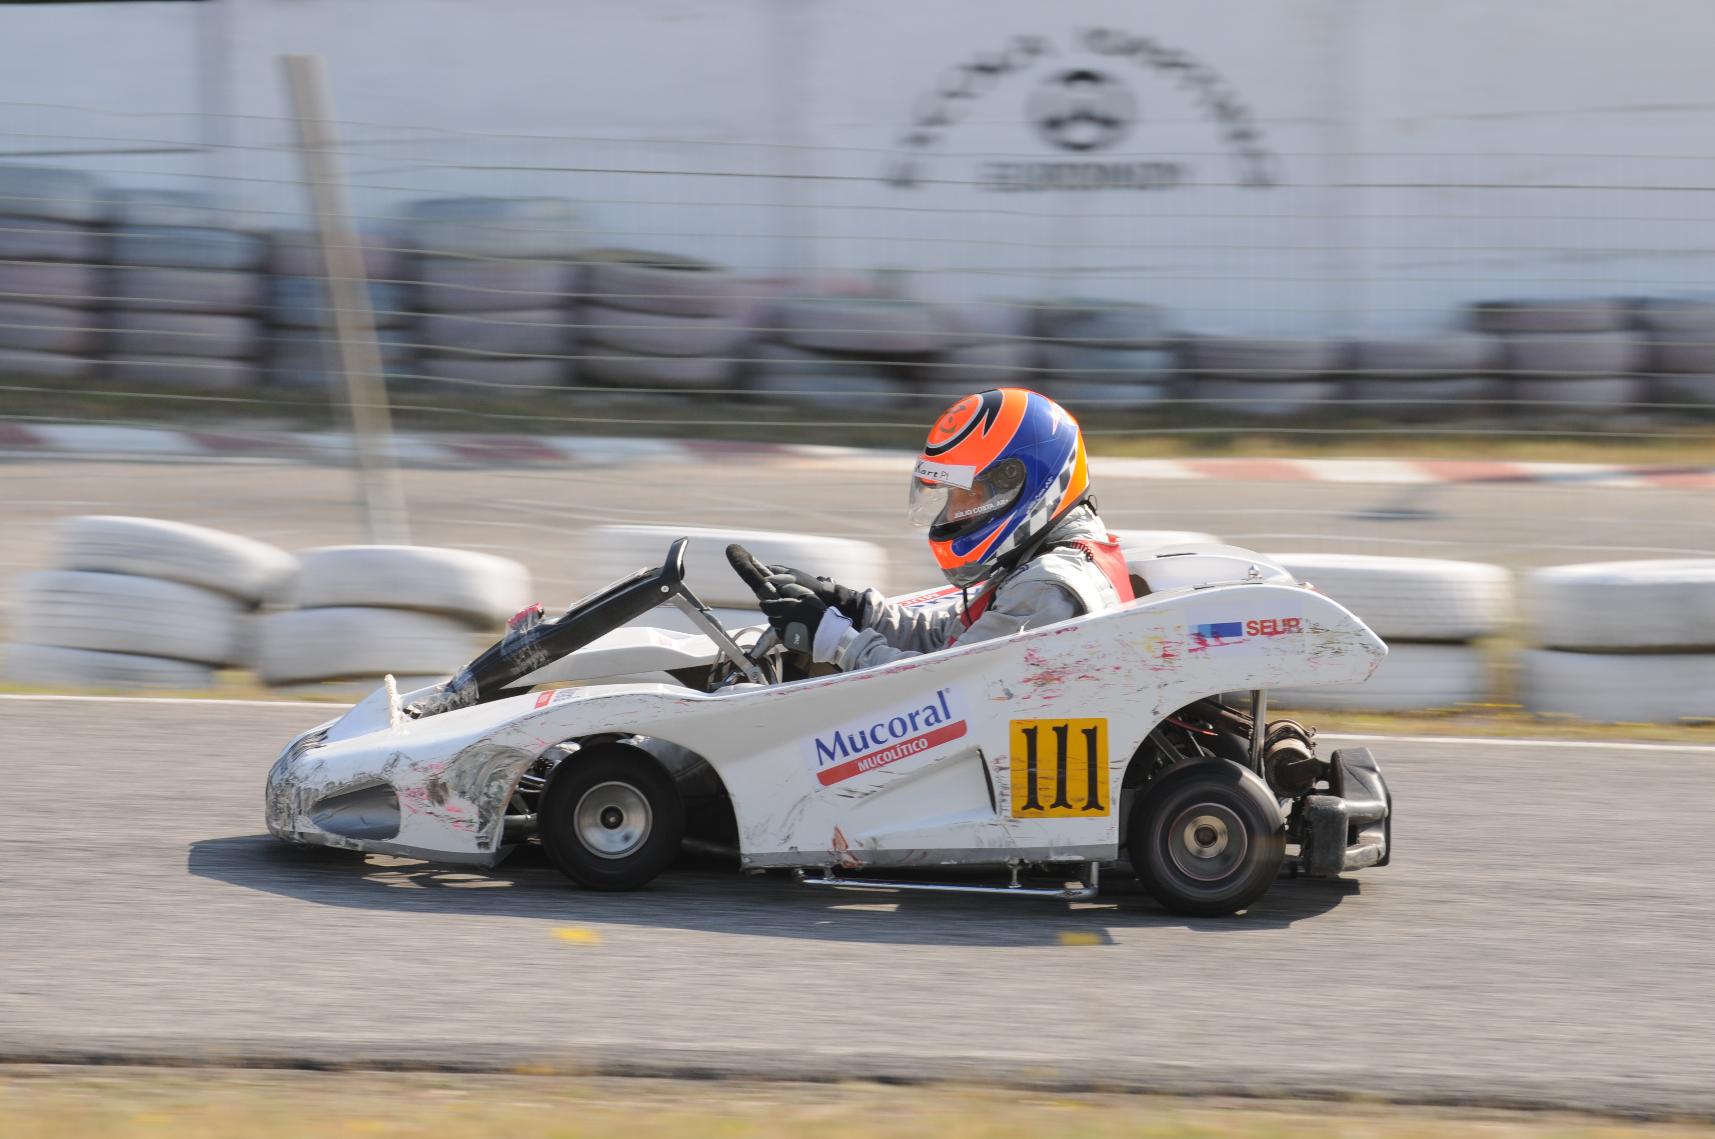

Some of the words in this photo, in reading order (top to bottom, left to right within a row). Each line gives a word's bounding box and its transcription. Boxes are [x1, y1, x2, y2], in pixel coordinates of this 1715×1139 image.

[1246, 618, 1303, 636] SEUR
[815, 689, 952, 766] Mucoral
[858, 738, 929, 772] MUCOLÍTICO
[1021, 723, 1105, 812] 111
